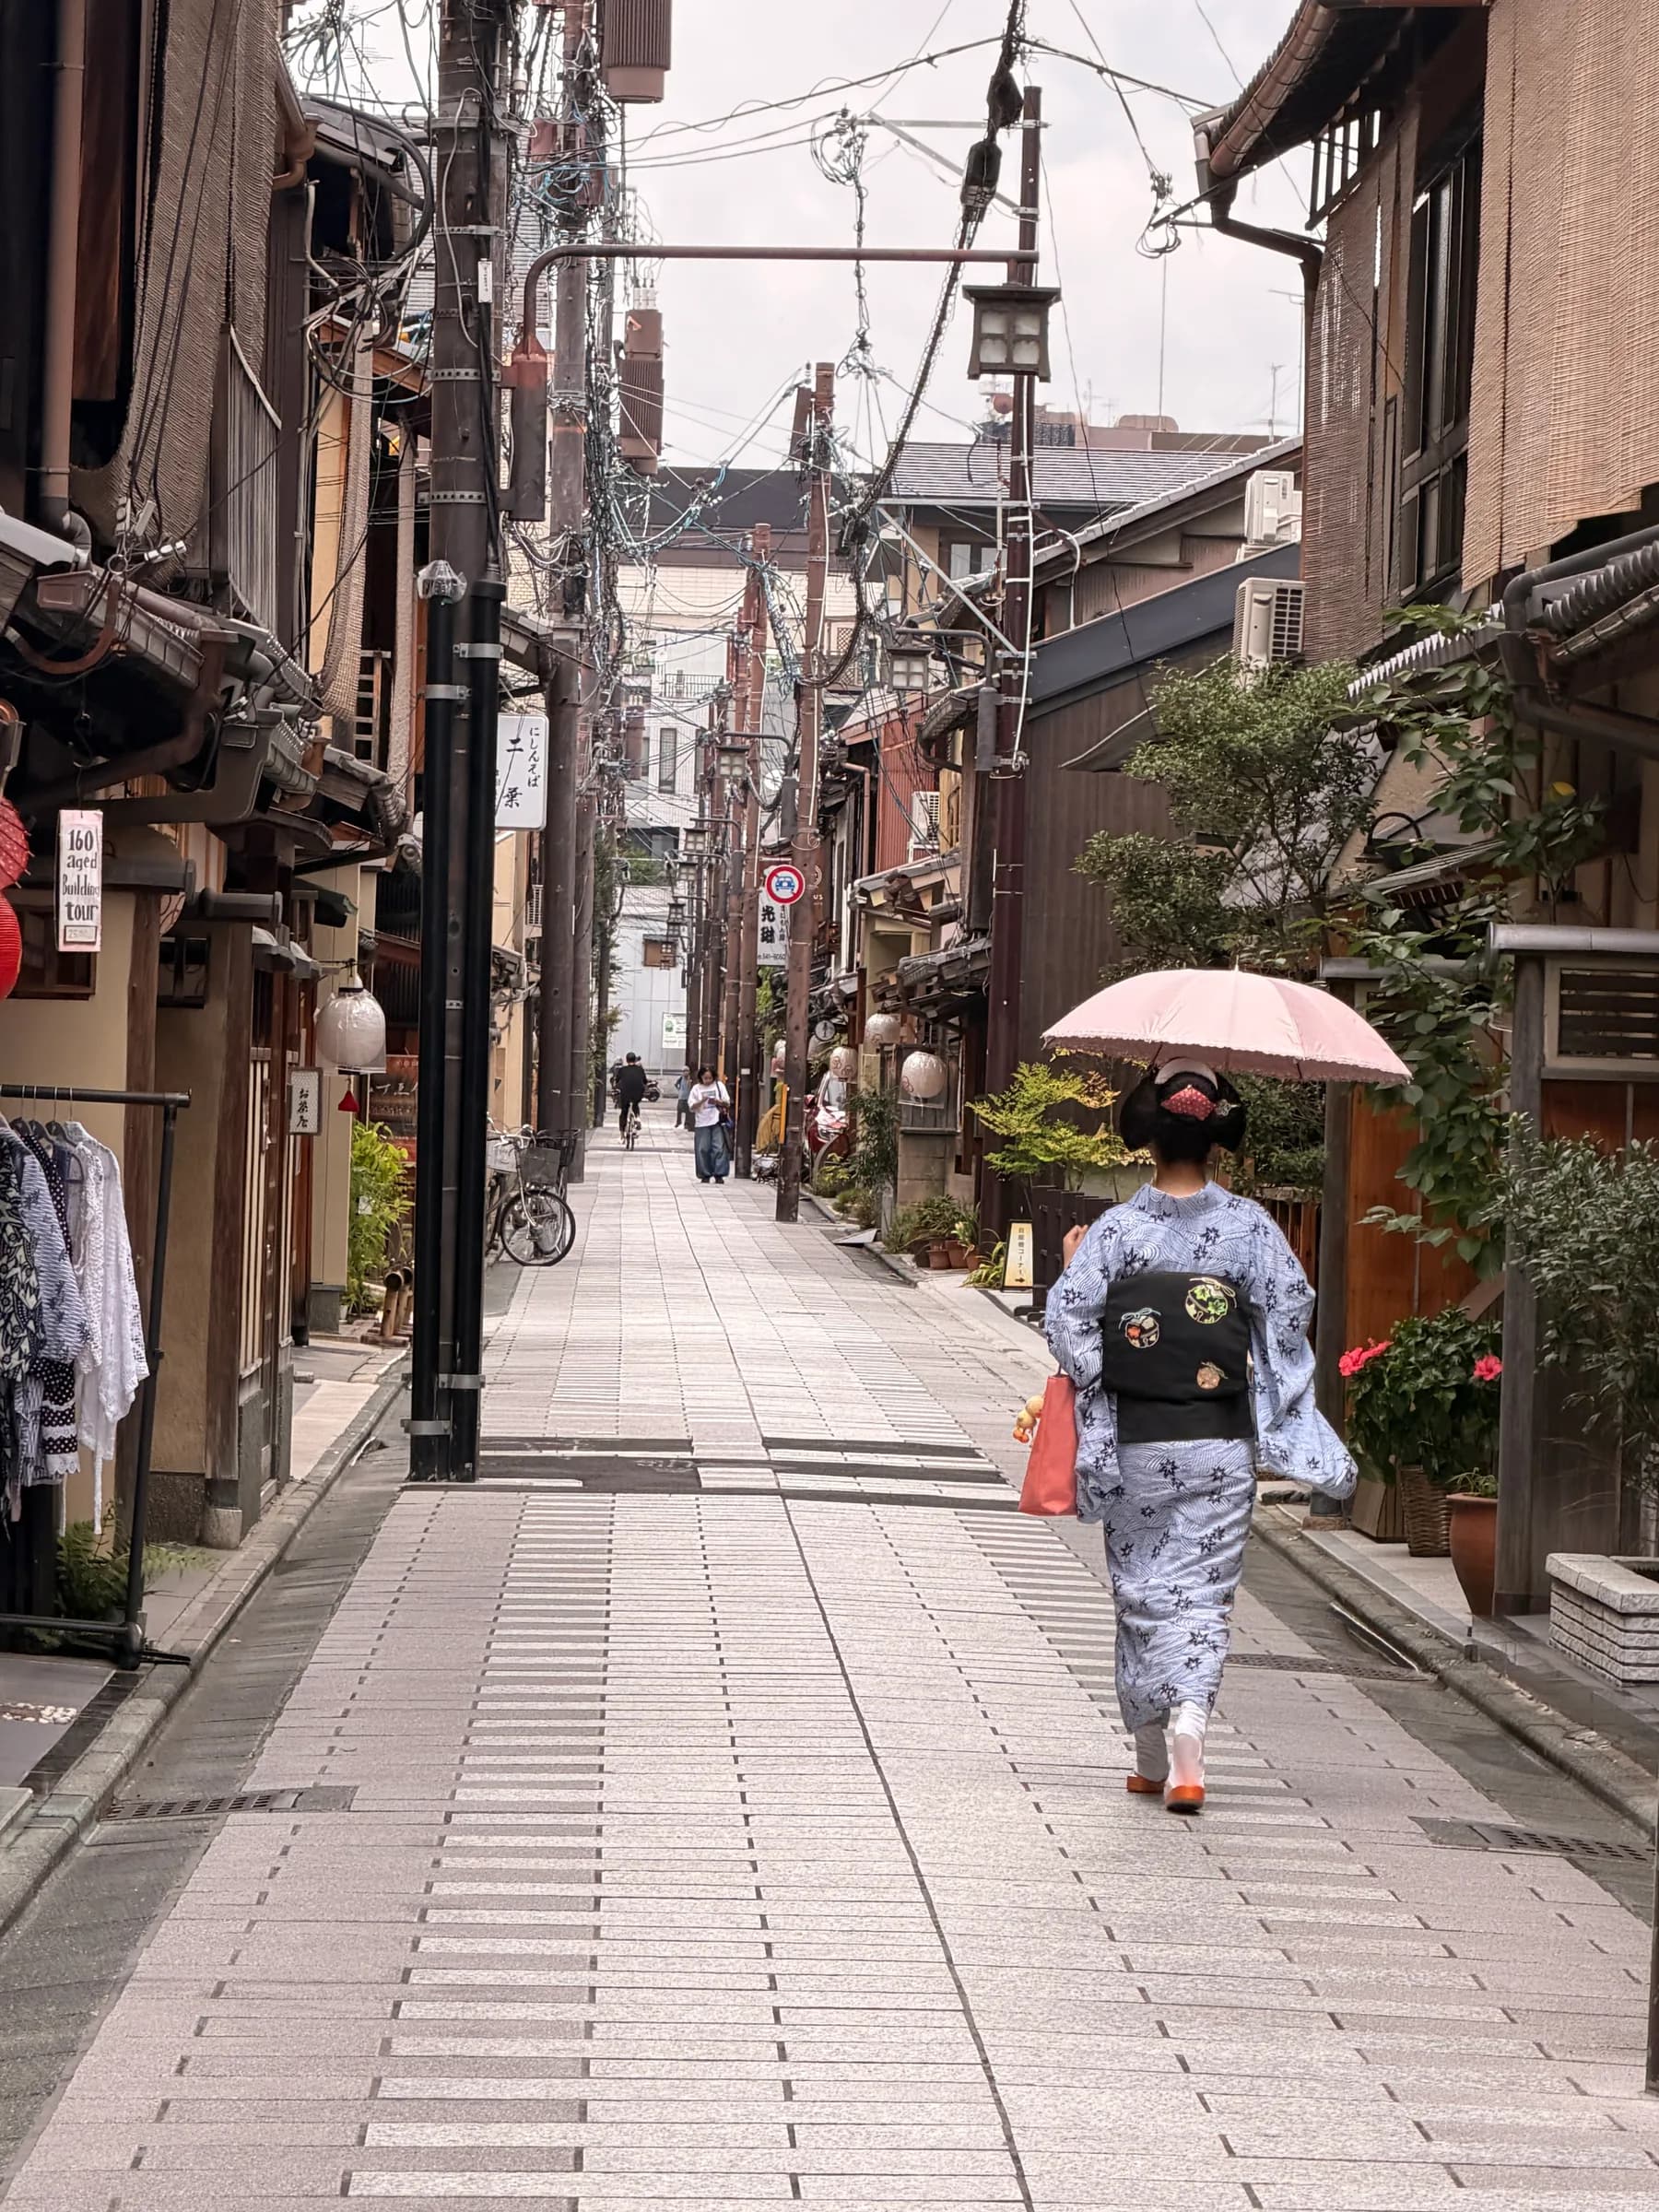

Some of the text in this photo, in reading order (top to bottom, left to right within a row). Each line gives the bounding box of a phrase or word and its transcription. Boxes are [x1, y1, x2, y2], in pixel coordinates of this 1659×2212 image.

[528, 727, 542, 787] にしんそば
[504, 737, 524, 808] 二葉
[67, 830, 94, 852] 160
[67, 853, 98, 872] aged
[65, 901, 100, 921] tour
